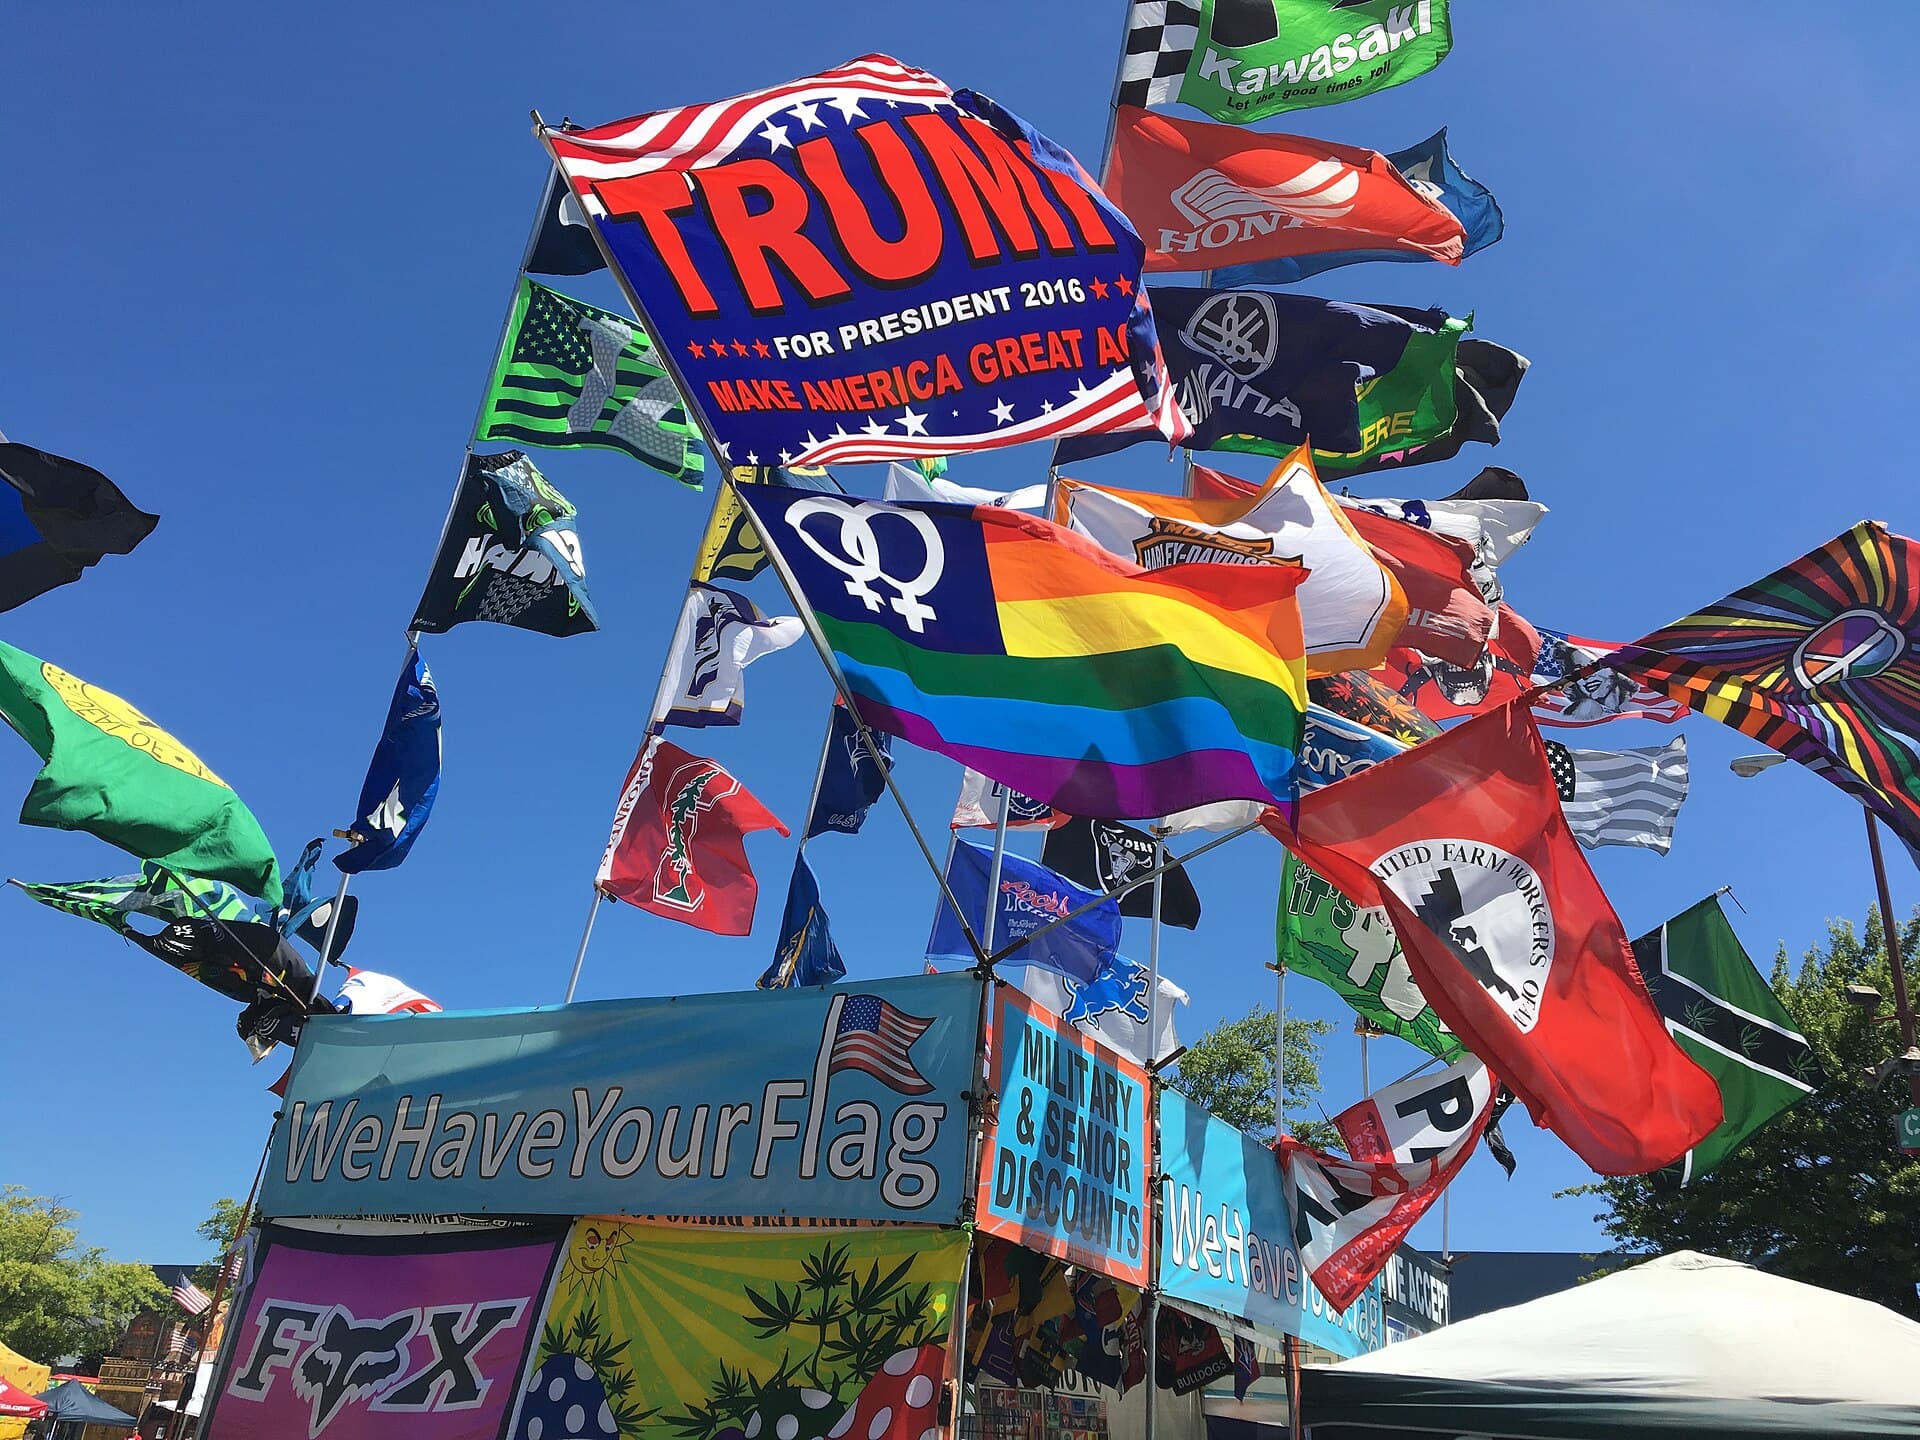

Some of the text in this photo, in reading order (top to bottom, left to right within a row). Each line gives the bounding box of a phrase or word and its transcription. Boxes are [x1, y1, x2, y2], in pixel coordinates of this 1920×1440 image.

[1226, 59, 1391, 111] Let the good times roll
[1155, 212, 1308, 254] HON
[773, 278, 1086, 360] FOR PRESIDENT 2016
[707, 378, 803, 412] MAKE
[802, 353, 964, 412] AMERICA
[969, 329, 1084, 384] GREAT
[1144, 543, 1272, 570] HARLEY-DAVID
[1377, 845, 1432, 880] ITED
[1442, 843, 1509, 873] FARM
[1507, 863, 1550, 968] WORKERS
[284, 992, 948, 1210] WeHaveYourFlag
[1022, 1022, 1133, 1133] MILITARY
[1016, 1086, 1131, 1193] & SENIOR
[994, 1146, 1140, 1259] DISCOUNTS
[1385, 1252, 1449, 1327] WE ACCEPT
[1176, 1360, 1227, 1389] BULLDOGS
